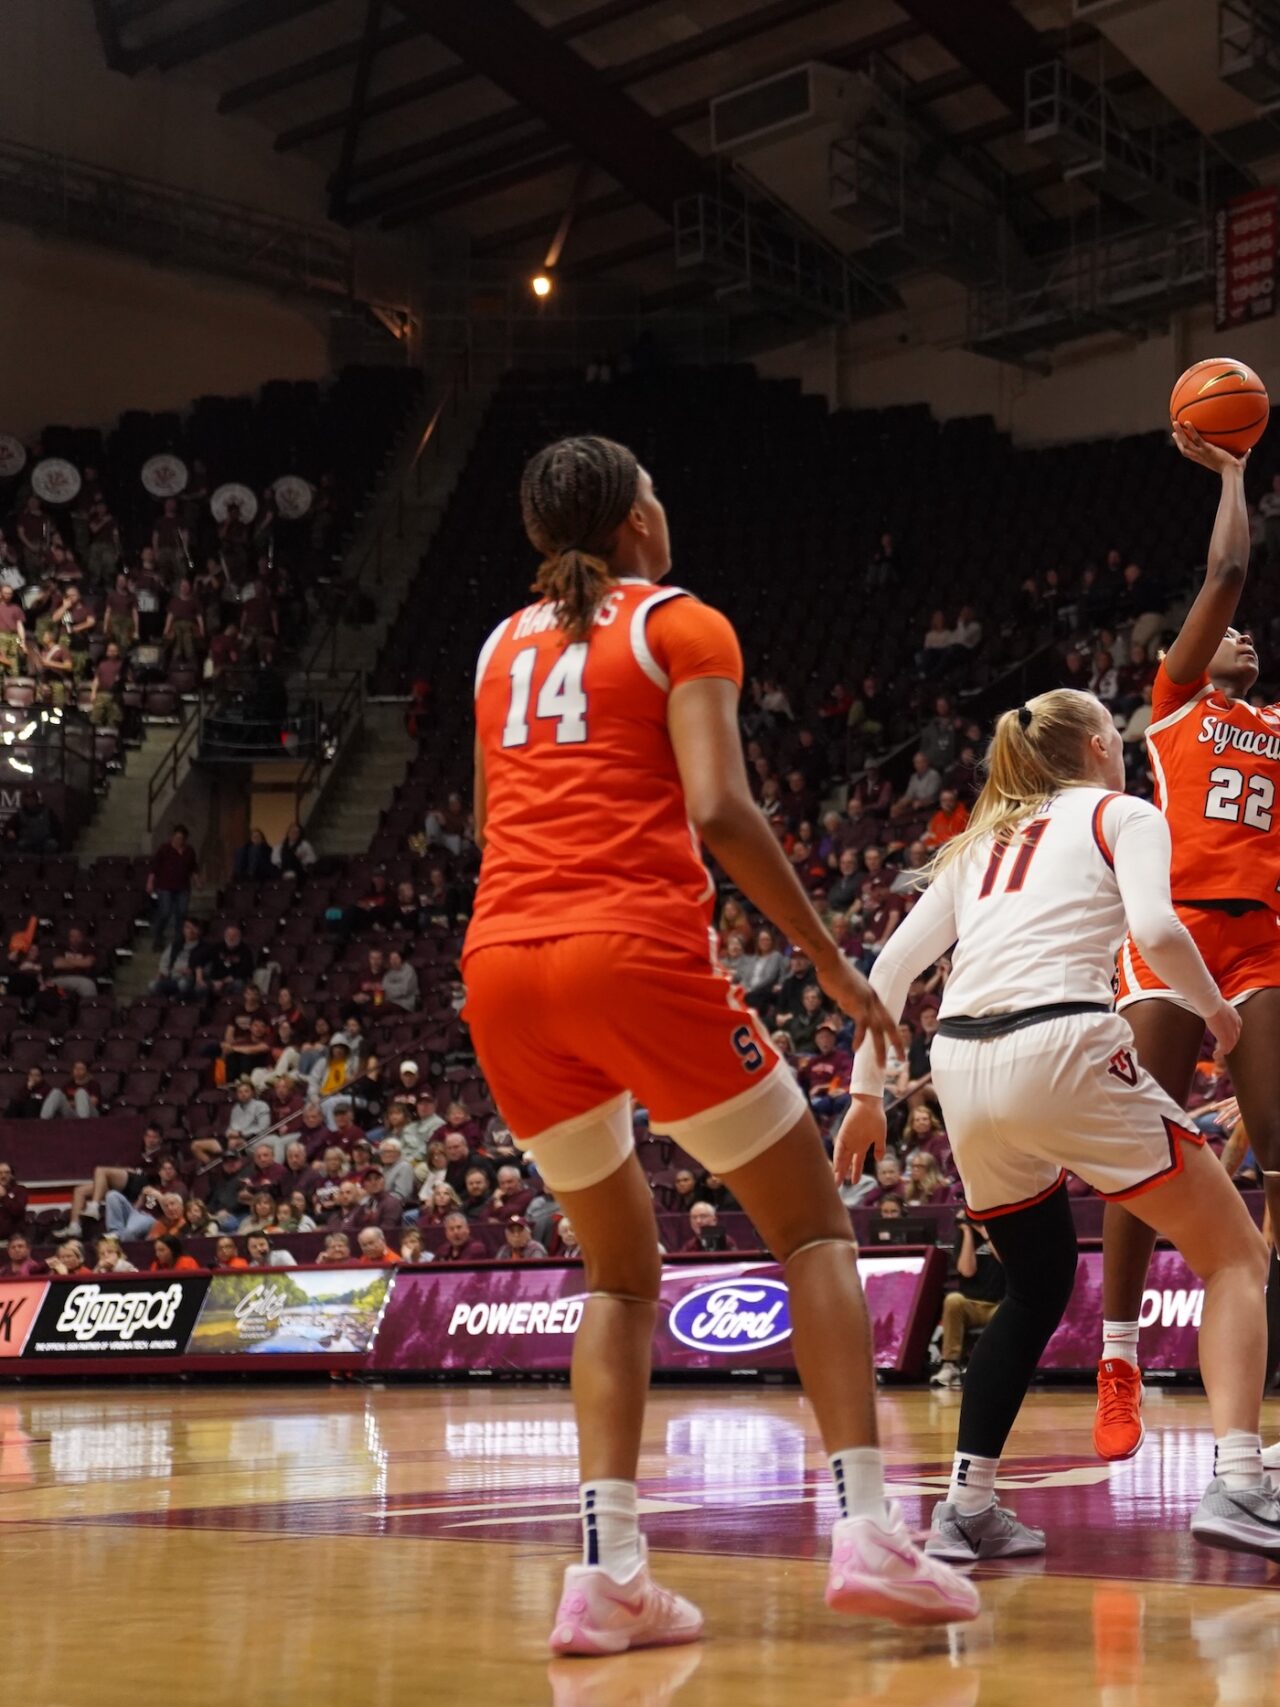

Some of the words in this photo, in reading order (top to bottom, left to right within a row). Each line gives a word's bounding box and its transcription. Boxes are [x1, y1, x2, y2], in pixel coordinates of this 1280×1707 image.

[502, 641, 588, 748] 14
[1205, 767, 1275, 832] 22
[979, 818, 1051, 900] 11
[732, 1025, 763, 1074] S
[0, 1297, 27, 1343] K
[57, 1283, 183, 1341] Signspot
[448, 1302, 583, 1336] POWERED
[690, 1291, 784, 1339] Ford
